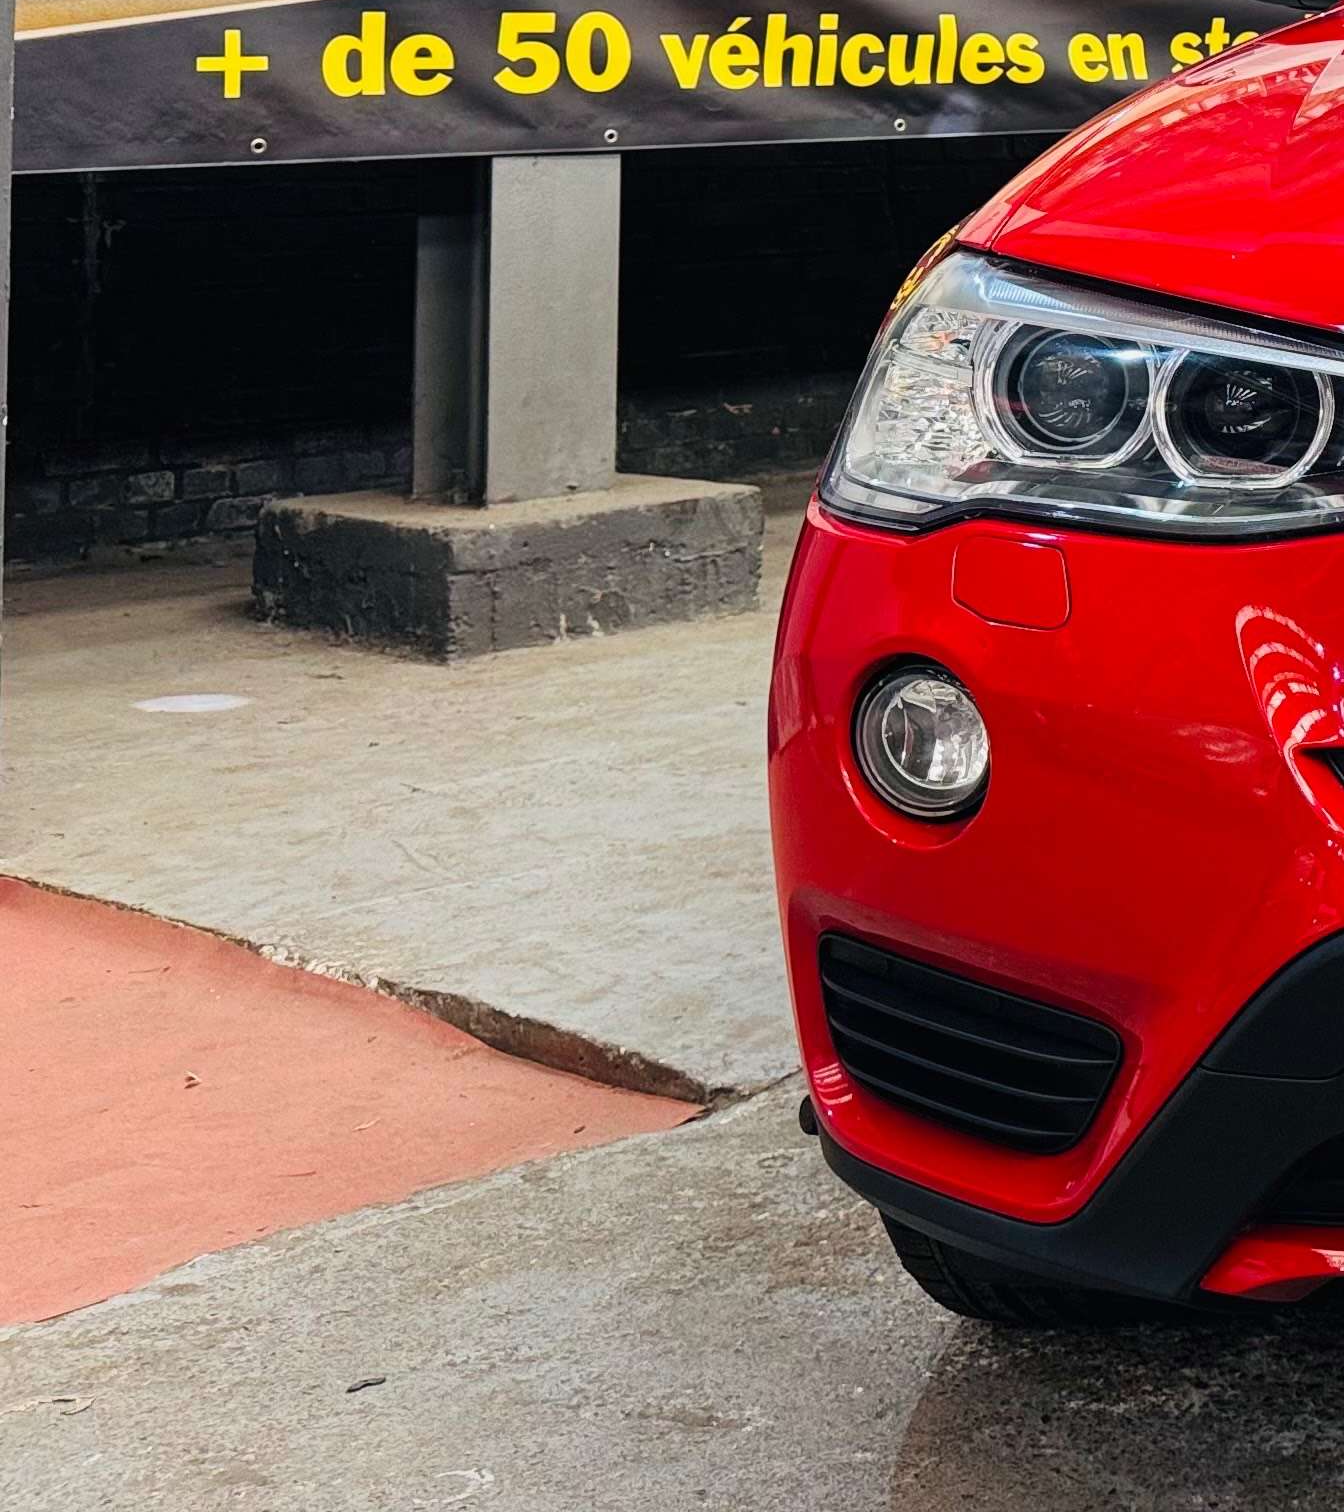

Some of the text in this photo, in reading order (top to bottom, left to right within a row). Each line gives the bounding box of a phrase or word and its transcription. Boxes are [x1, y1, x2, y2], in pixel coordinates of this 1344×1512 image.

[323, 12, 454, 97] de
[496, 12, 632, 94] 50
[660, 13, 1044, 90] véhicules
[1068, 34, 1148, 82] en
